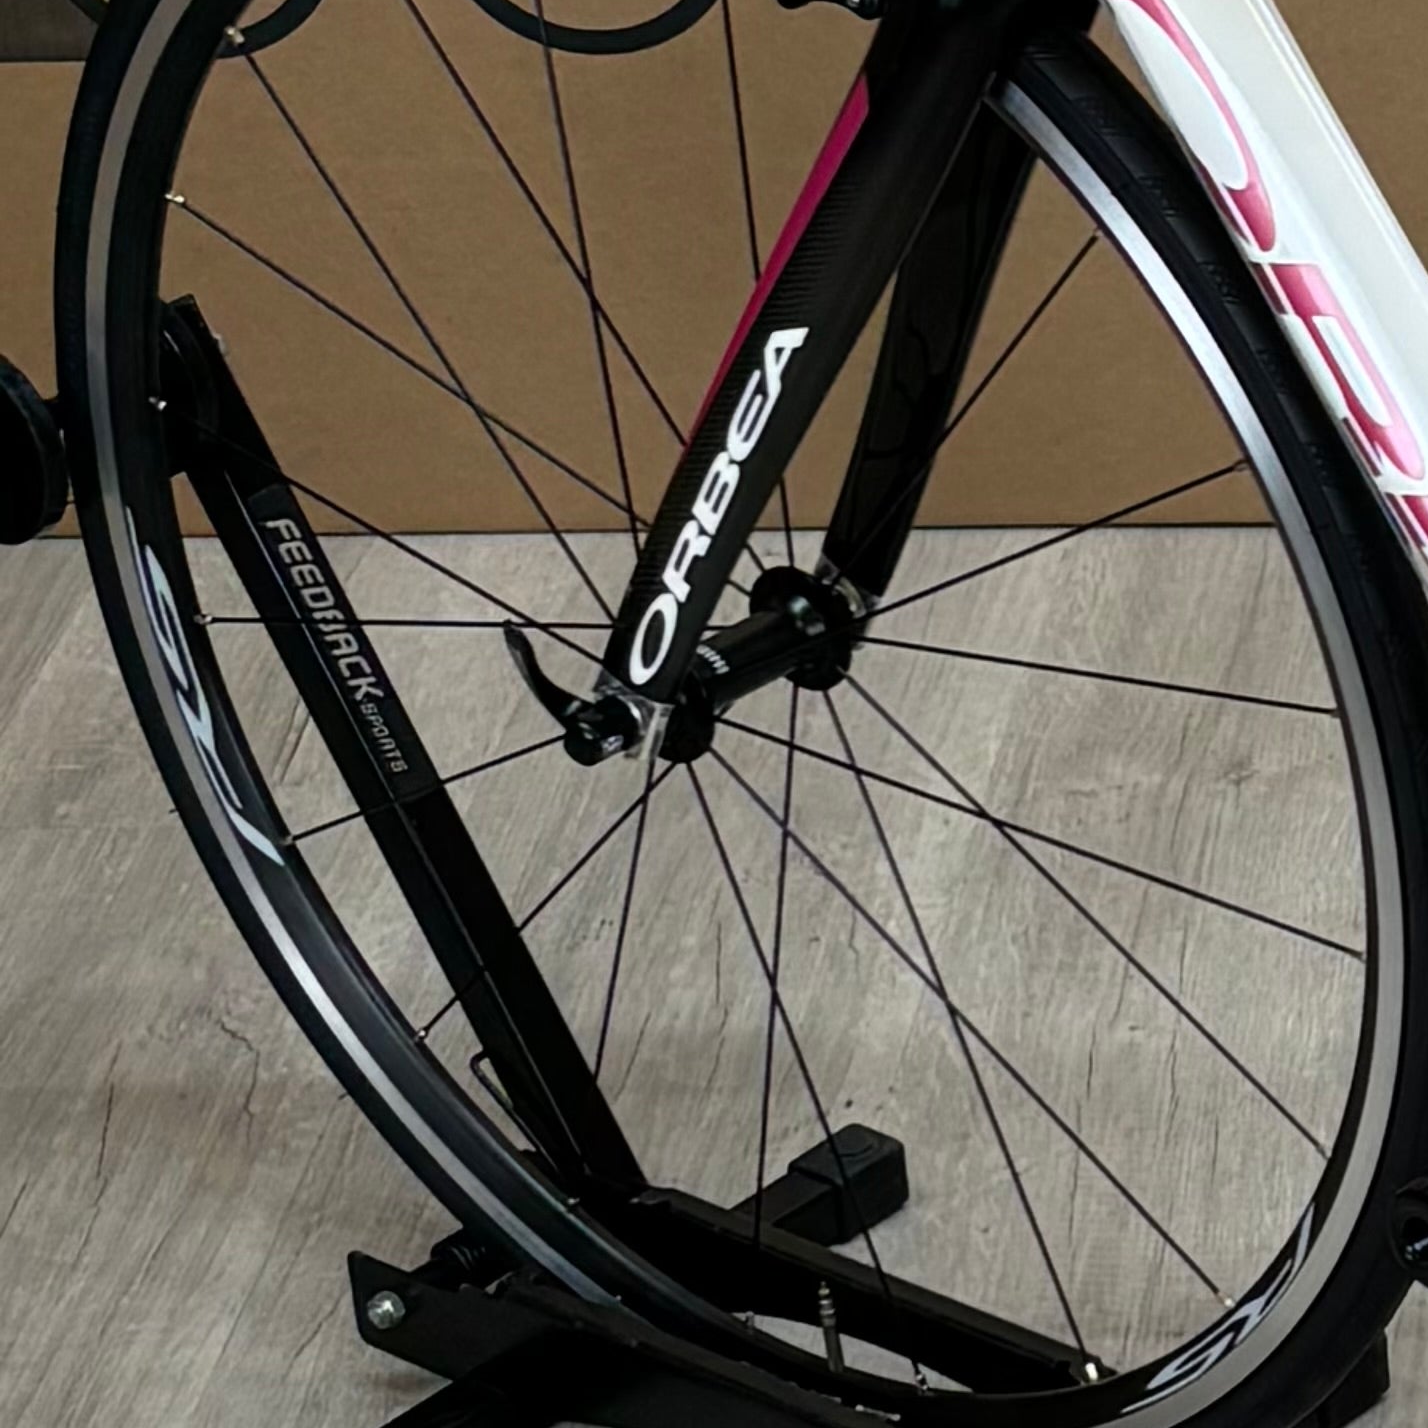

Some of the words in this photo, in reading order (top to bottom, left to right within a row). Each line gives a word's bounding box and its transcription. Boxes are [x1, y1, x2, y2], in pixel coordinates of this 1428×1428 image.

[264, 516, 386, 704] FEEDBACK
[360, 700, 409, 774] SPORTS
[628, 326, 809, 686] ORBEA
